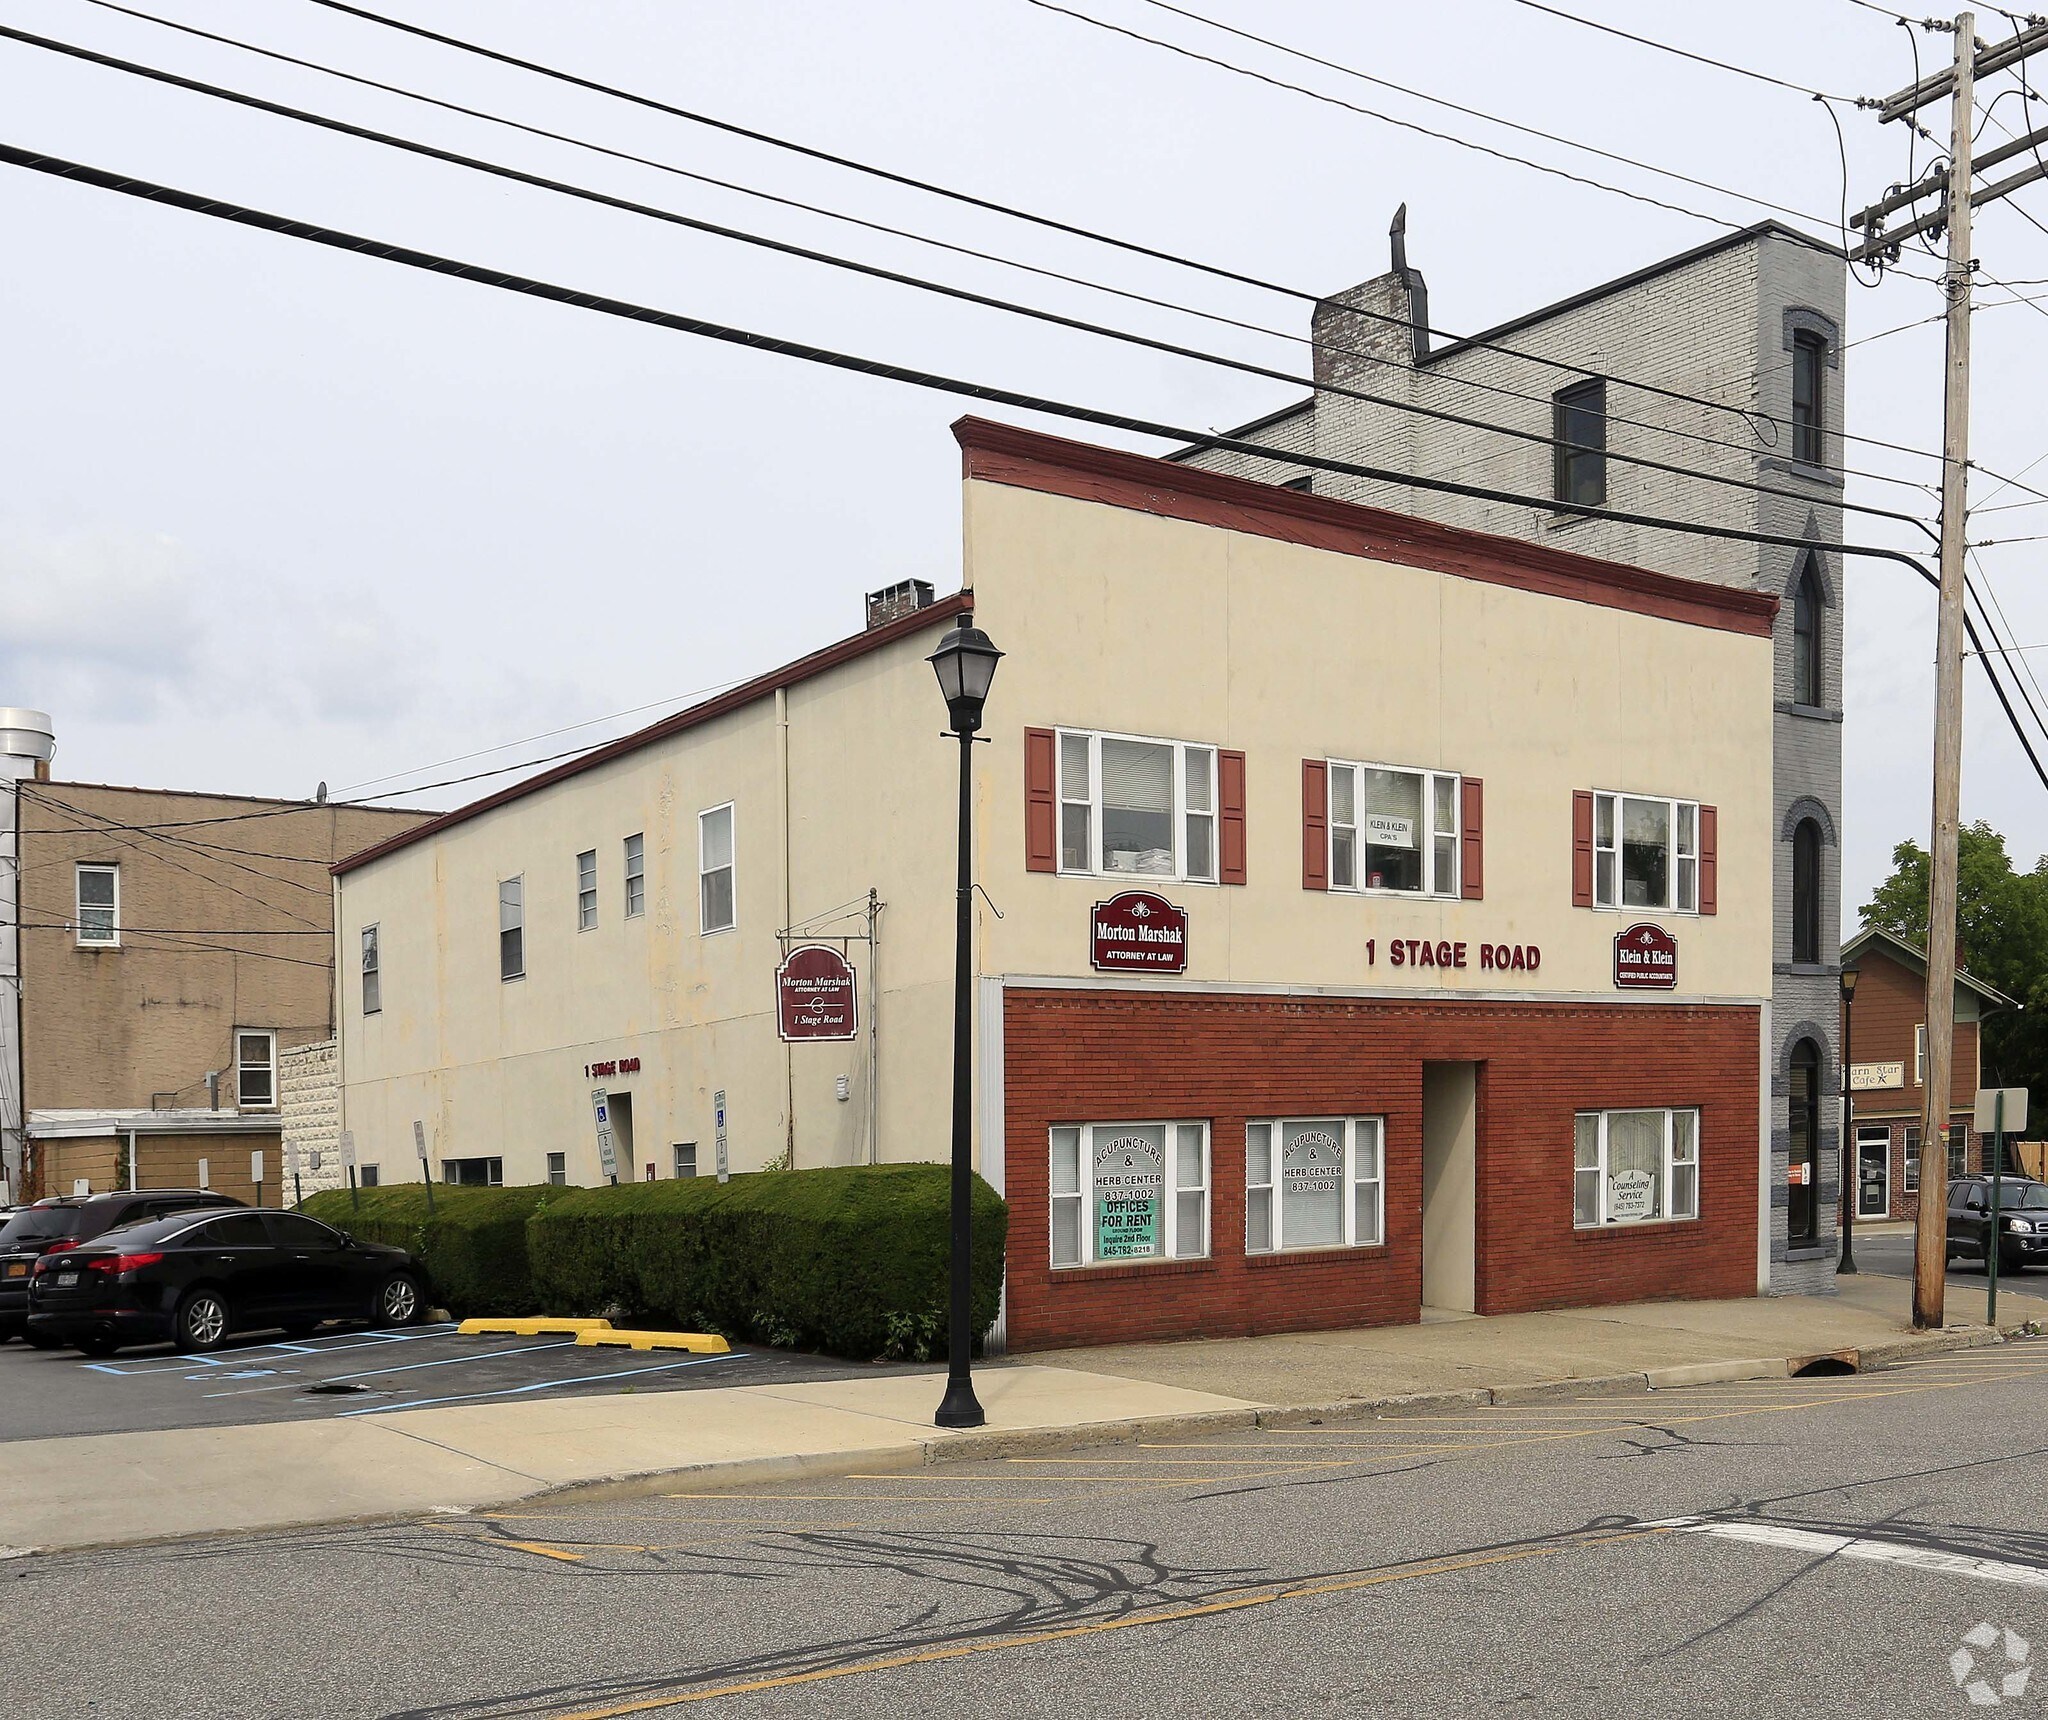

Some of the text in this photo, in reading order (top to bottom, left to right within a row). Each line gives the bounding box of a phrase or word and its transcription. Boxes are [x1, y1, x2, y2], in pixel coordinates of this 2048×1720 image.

[1370, 820, 1408, 832] KLEIN & KLEIN
[1380, 833, 1398, 841] CPA'S
[1097, 922, 1183, 944] Morton Marshak
[1106, 950, 1174, 962] ATTORNEY AT LAW
[1366, 938, 1541, 970] 1 STAGE ROAD
[1619, 949, 1673, 965] Klein & Klein
[782, 976, 851, 987] Morton Marshak
[1636, 972, 1649, 980] PUBLIC
[800, 1015, 822, 1026] Stage
[823, 1014, 844, 1024] Road
[584, 1057, 641, 1078] 1 STAGE ROAD
[1876, 1065, 1900, 1075] Star
[1852, 1075, 1876, 1086] Cafe
[1284, 1131, 1342, 1161] ACUPUNCTURE
[1095, 1137, 1162, 1169] ACUPUNCTURE
[1309, 1147, 1318, 1160] &
[1124, 1154, 1134, 1167] &
[1284, 1166, 1342, 1177] HERB CENTER
[1629, 1171, 1634, 1180] A
[1095, 1174, 1162, 1187] HERB CENTER
[1292, 1181, 1335, 1191] 837-1002
[1612, 1180, 1650, 1191] Counseling
[1104, 1189, 1155, 1201] 837-1002
[1618, 1190, 1643, 1201] Service
[1106, 1200, 1149, 1213] OFFICES
[1101, 1214, 1152, 1228] FOR RENT
[1103, 1233, 1151, 1245] Inquire 2nd Floor
